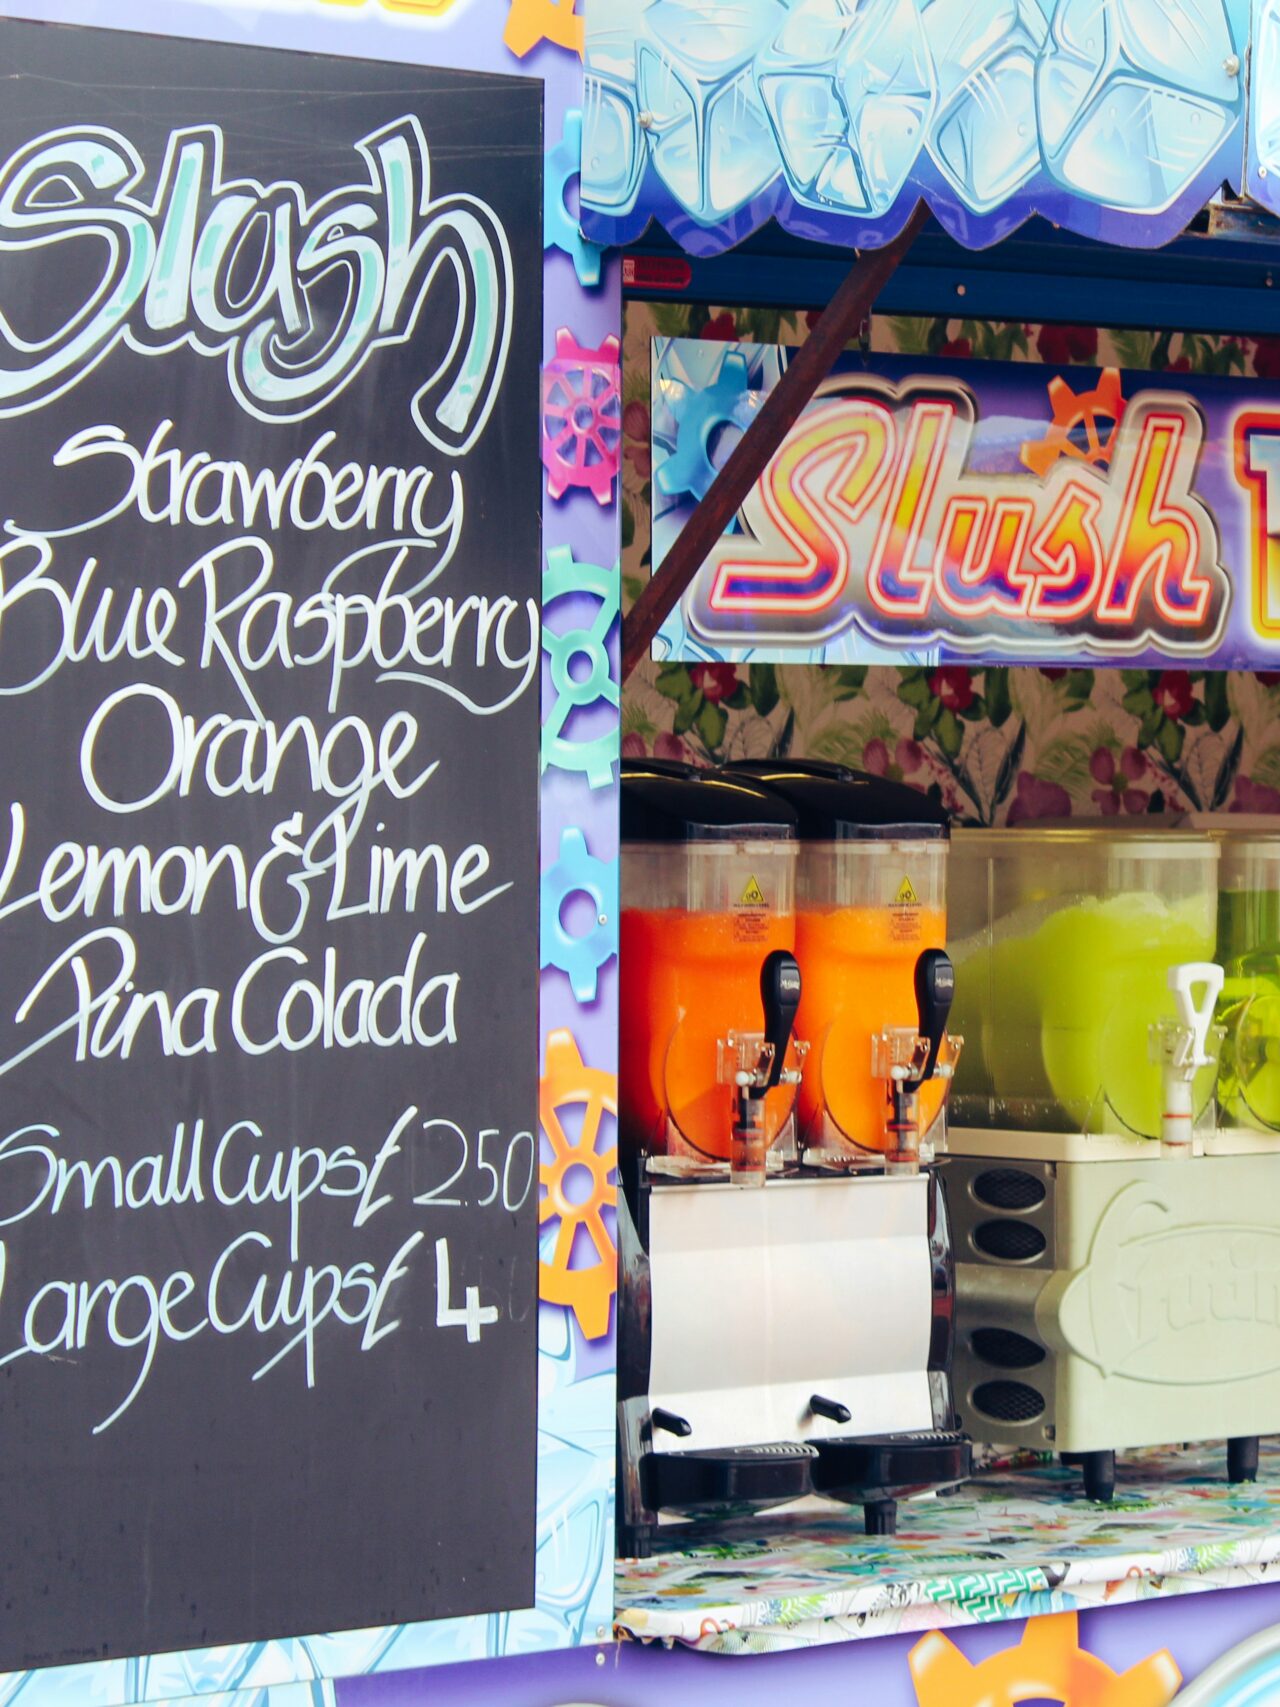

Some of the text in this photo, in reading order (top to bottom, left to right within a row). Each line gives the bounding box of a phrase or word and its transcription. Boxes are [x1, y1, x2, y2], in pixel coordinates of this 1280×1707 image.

[0, 115, 514, 457] Slush
[3, 420, 464, 612] Strawberry
[708, 394, 1214, 626] Slush
[0, 534, 540, 729] Blue Raspberry
[80, 683, 440, 870] Orange
[0, 802, 514, 944] Lemon & Lime
[231, 932, 460, 1055] Colada
[0, 1119, 205, 1226] Small
[213, 1120, 368, 1262] Cups
[208, 1231, 377, 1389] Cups
